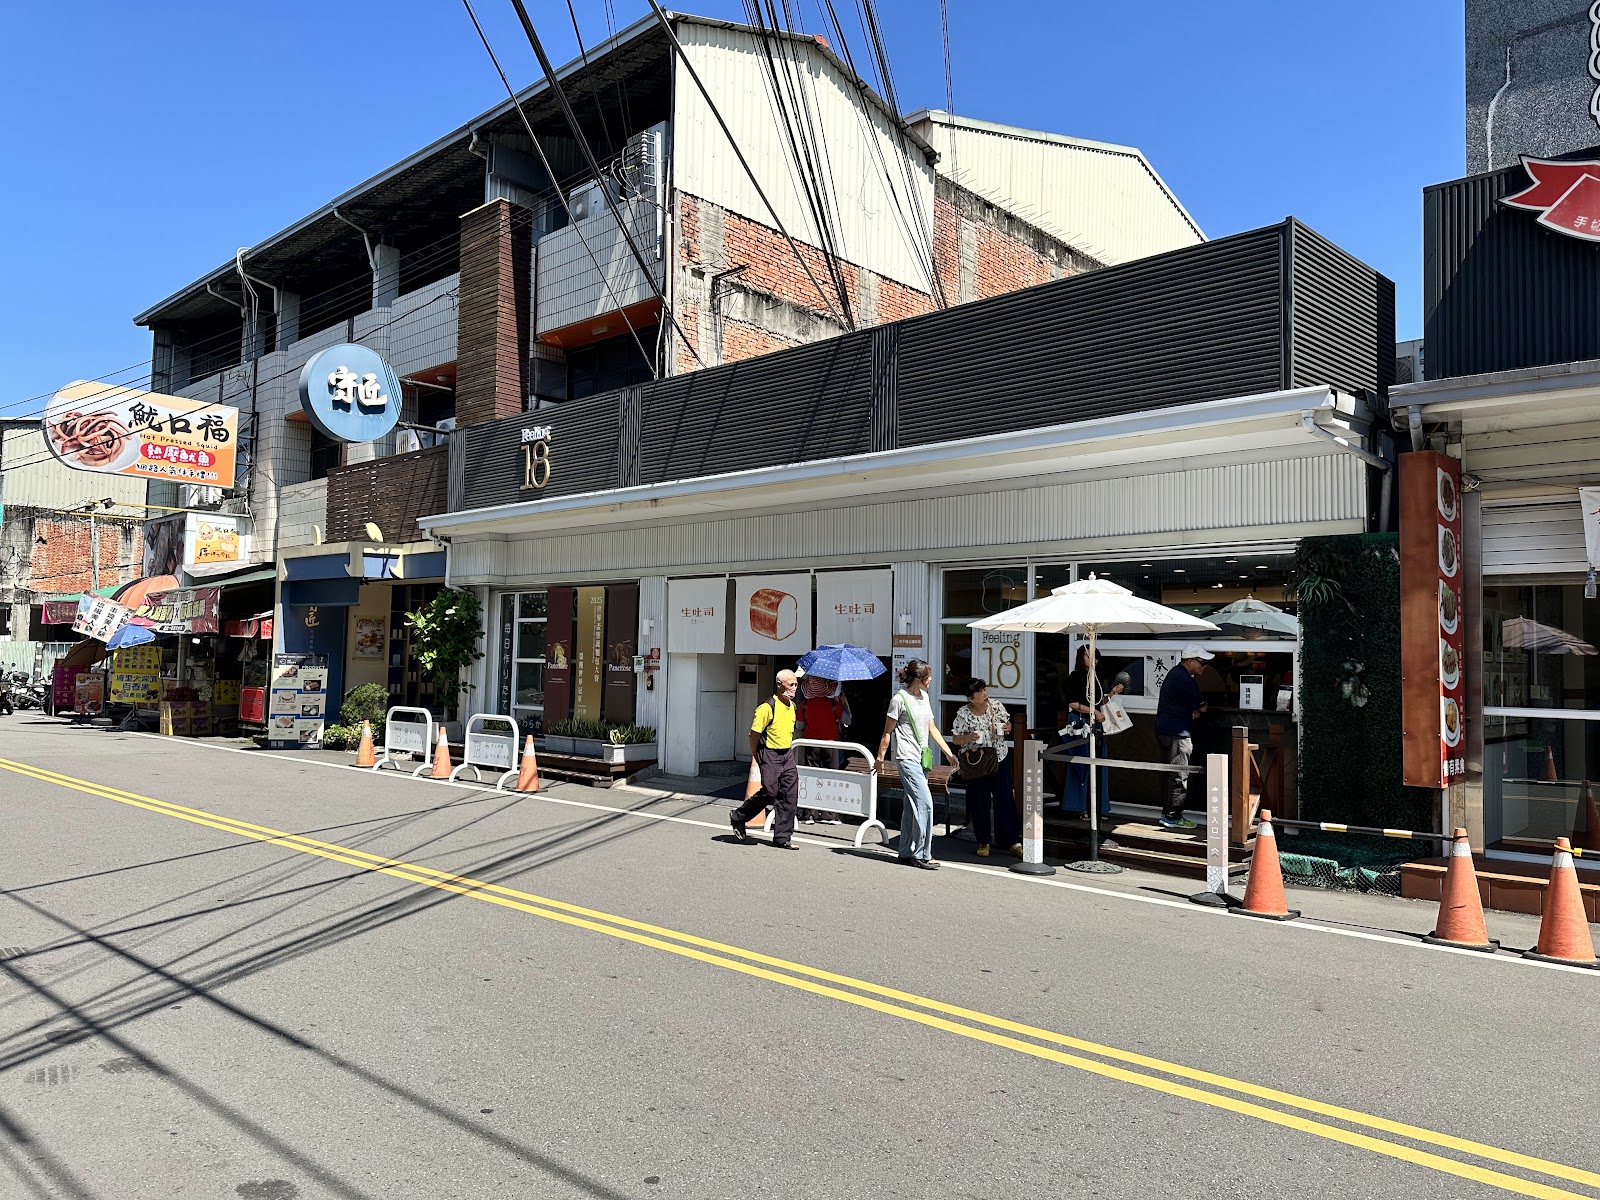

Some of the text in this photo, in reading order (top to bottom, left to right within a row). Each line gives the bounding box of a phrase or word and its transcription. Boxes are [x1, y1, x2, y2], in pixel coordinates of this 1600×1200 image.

[521, 426, 552, 442] Feeling
[160, 436, 192, 446] Pressed
[196, 441, 218, 450] Squid
[147, 443, 210, 466] 熱壓魷魚
[519, 441, 551, 490] 18
[681, 606, 715, 618] 生吐司
[834, 603, 875, 615] 生吐司
[982, 632, 1021, 648] Feeling
[982, 646, 1021, 689] 18
